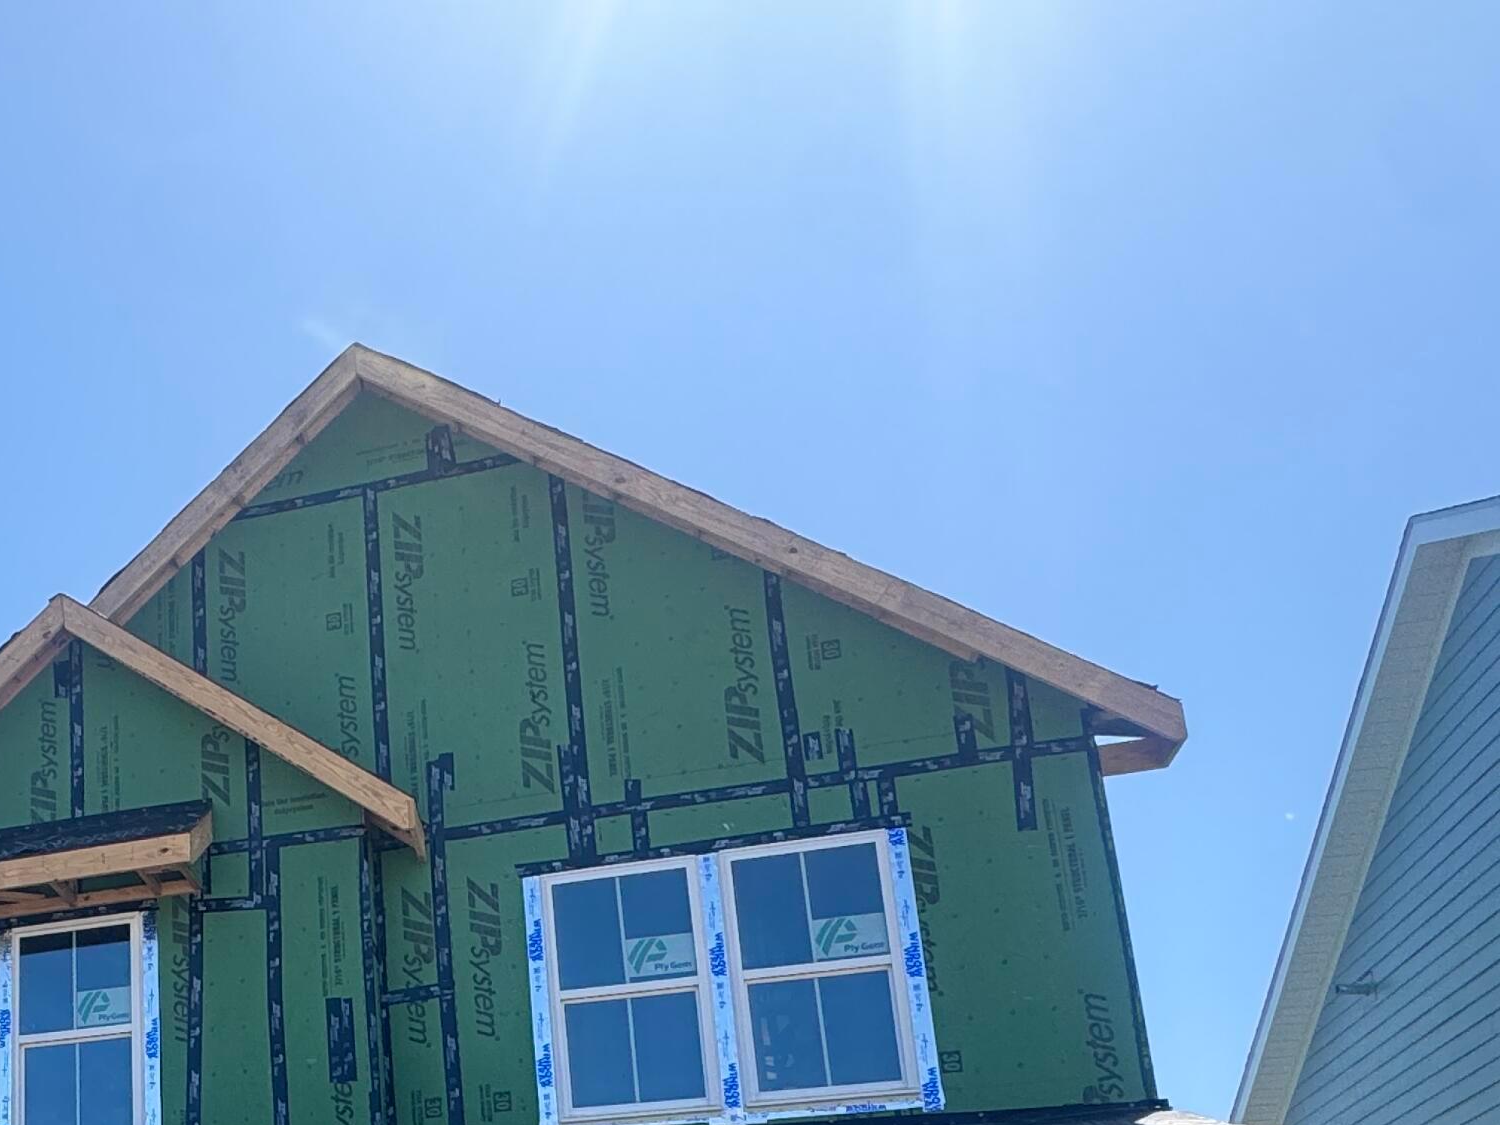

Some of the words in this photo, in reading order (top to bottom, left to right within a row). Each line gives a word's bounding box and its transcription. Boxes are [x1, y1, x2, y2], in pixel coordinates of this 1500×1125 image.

[511, 577, 528, 597] 30
[822, 640, 841, 660] 30
[844, 943, 859, 953] Ply
[861, 941, 885, 950] Gem
[654, 961, 669, 972] Ply
[943, 1052, 962, 1073] 30
[425, 1098, 442, 1118] 30
[493, 1092, 511, 1112] 30
